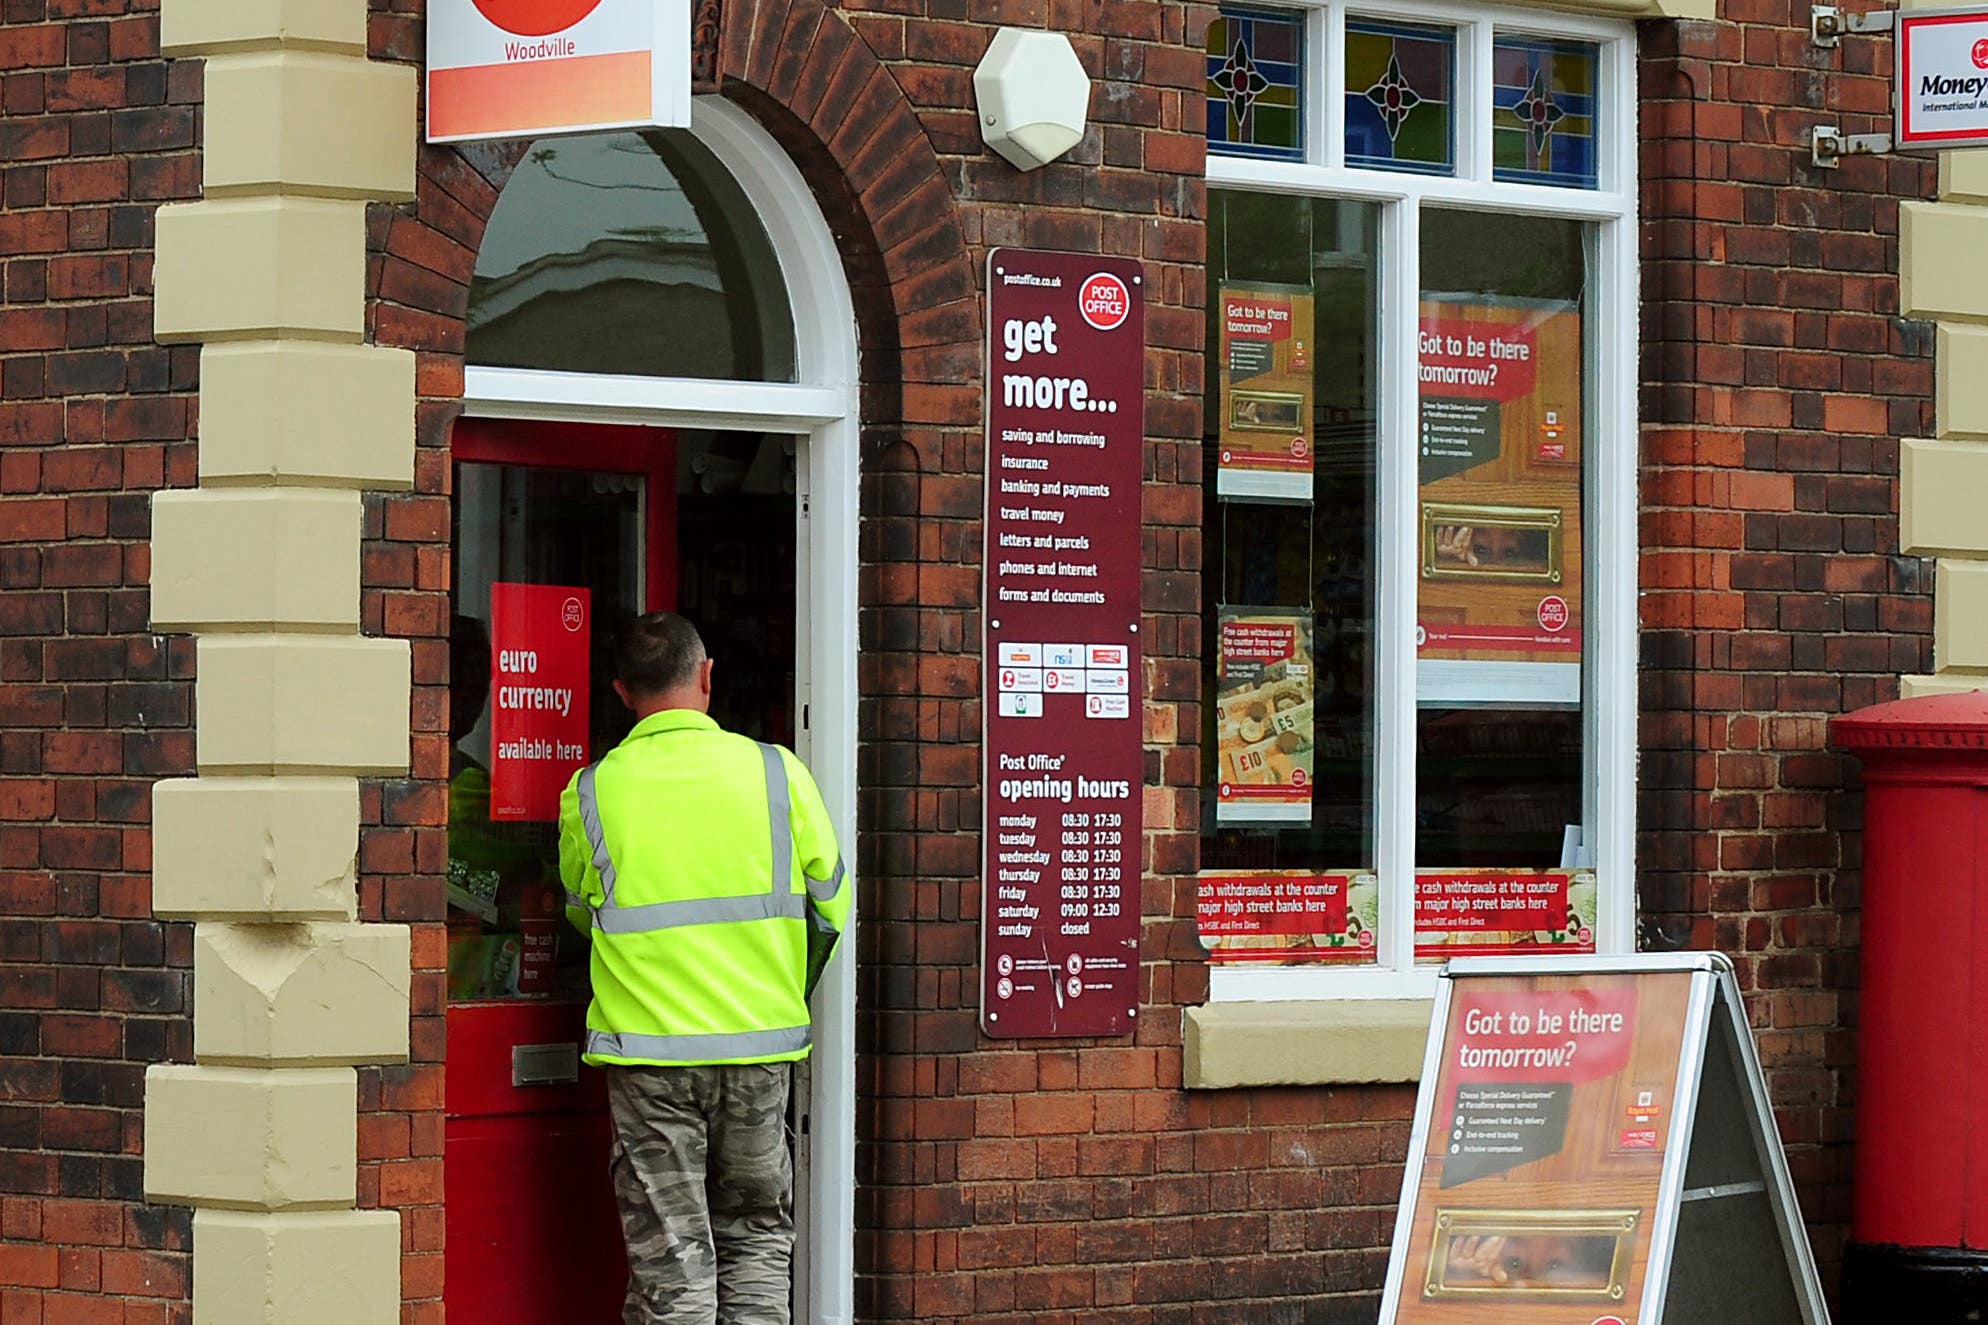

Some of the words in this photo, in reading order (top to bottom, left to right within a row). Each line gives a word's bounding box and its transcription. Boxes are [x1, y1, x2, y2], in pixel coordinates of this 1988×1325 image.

[505, 38, 575, 61] Woodville
[1920, 74, 1988, 98] Money
[1922, 101, 1977, 112] International
[1003, 274, 1062, 287] postoffice.co.uk
[1091, 285, 1119, 300] POST
[1085, 300, 1123, 315] OFFICE
[1227, 304, 1244, 317] Got
[1244, 306, 1254, 318] to
[1255, 306, 1266, 319] be
[1267, 307, 1288, 320] there
[1227, 321, 1272, 334] tomorrow?
[1003, 315, 1058, 362] get
[1418, 331, 1442, 354] Got
[1447, 334, 1462, 356] to
[1467, 335, 1486, 358] be
[1490, 337, 1529, 360] there
[1418, 361, 1498, 386] tomorrow?
[1003, 375, 1117, 413] more...
[1002, 428, 1033, 445] saving
[1036, 430, 1054, 444] and
[1056, 430, 1105, 448] borrowing
[1002, 454, 1048, 470] insurance
[1001, 479, 1040, 496] banking
[1042, 481, 1060, 494] and
[1063, 484, 1110, 498] payments
[1001, 506, 1029, 520] travel
[1032, 510, 1064, 524] money
[1000, 533, 1031, 547] letters
[1034, 535, 1052, 548] and
[1055, 536, 1089, 550] parcels
[1000, 560, 1034, 576] phones
[1037, 562, 1055, 575] and
[1058, 562, 1097, 576] internet
[999, 587, 1028, 600] forms
[1031, 588, 1049, 602] and
[1052, 589, 1105, 603] documents
[1544, 603, 1562, 613] POST
[1541, 613, 1564, 622] OFFICE
[499, 650, 537, 673] euro
[499, 685, 572, 718] currency
[1278, 715, 1295, 731] £5
[498, 736, 552, 760] available
[556, 739, 583, 761] here
[1000, 754, 1025, 770] Post
[1239, 751, 1262, 772] £10
[1000, 774, 1072, 803] opening
[1078, 775, 1129, 799] hours
[999, 814, 1036, 830] monday
[1061, 814, 1089, 827] 08:30
[1093, 814, 1121, 827] 17:30
[999, 832, 1036, 847] tuesday
[1061, 832, 1089, 845] 08:30
[1093, 832, 1121, 845] 17:30
[999, 850, 1050, 866] wednesday
[1061, 849, 1089, 863] 08:30
[1093, 849, 1121, 863] 17:30
[999, 868, 1040, 883] thursday
[1061, 867, 1089, 881] 08:30
[1093, 867, 1121, 881] 17:30
[999, 886, 1026, 901] friday
[1061, 885, 1089, 899] 08:30
[1093, 885, 1121, 899] 17:30
[1198, 884, 1214, 896] ash
[1217, 882, 1272, 896] withdrawals
[1274, 883, 1284, 896] at
[1286, 882, 1301, 895] the
[1303, 883, 1338, 895] counter
[1422, 881, 1442, 893] cash
[1445, 880, 1496, 894] withdrawals
[1499, 882, 1508, 893] at
[1510, 881, 1524, 893] the
[1526, 882, 1559, 893] counter
[999, 904, 1039, 919] saturday
[1061, 903, 1089, 917] 09:00
[1093, 903, 1121, 917] 12:30
[1224, 900, 1244, 916] high
[1246, 901, 1274, 913] street
[1276, 899, 1303, 913] banks
[1305, 900, 1326, 912] here
[1424, 899, 1449, 913] major
[1451, 897, 1469, 913] high
[1472, 898, 1499, 910] street
[1500, 897, 1526, 909] banks
[1528, 897, 1548, 909] here
[999, 922, 1032, 937] sunday
[1061, 922, 1090, 935] closed
[1465, 1008, 1502, 1035] Got
[1508, 1011, 1530, 1035] to
[1536, 1008, 1561, 1034] be
[1569, 1008, 1623, 1033] there
[1460, 1041, 1577, 1068] tomorrow?
